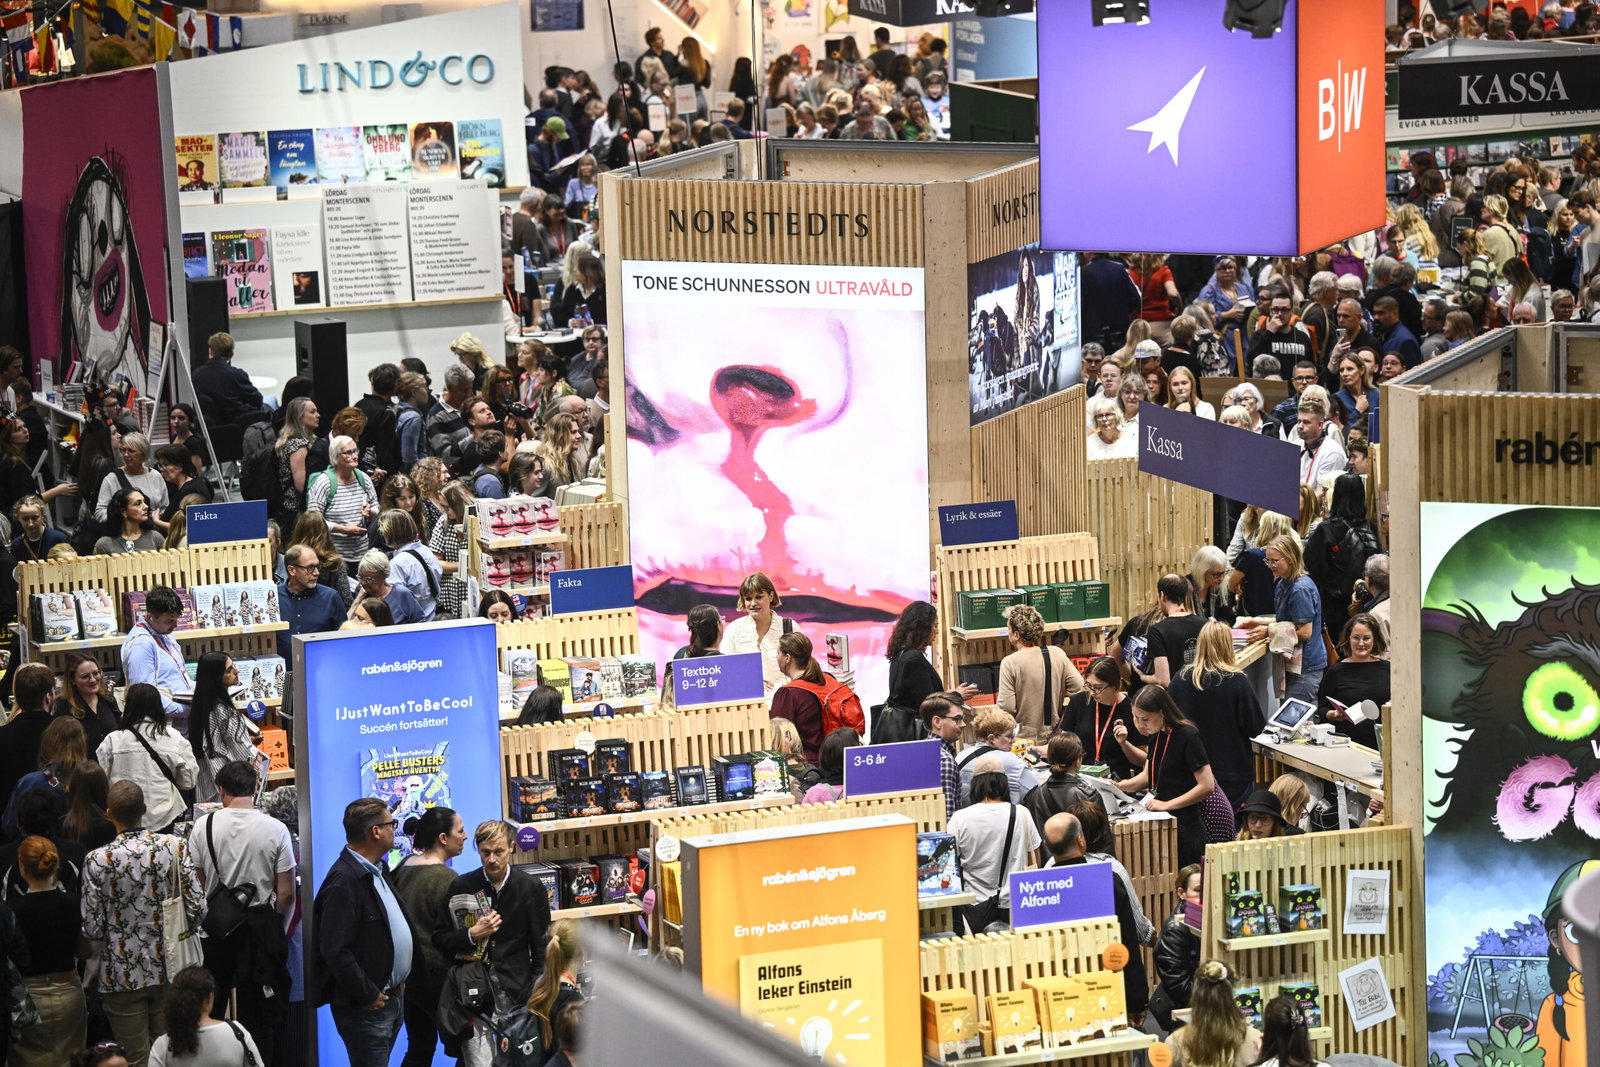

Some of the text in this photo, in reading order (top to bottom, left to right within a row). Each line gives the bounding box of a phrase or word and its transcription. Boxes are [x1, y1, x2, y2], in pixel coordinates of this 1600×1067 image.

[296, 50, 495, 93] LIND&CO
[1459, 70, 1569, 106] KASSA
[1398, 116, 1480, 129] EVIGA KLASSIKER
[180, 137, 208, 146] MAO-
[325, 189, 348, 197] LÖRDAG
[409, 187, 431, 195] LÖRDAG
[992, 190, 1040, 228] NORST
[668, 209, 869, 238] NORSTEDTS
[632, 275, 913, 298] TONE SCHUNNESSON ULTRAVÅLD
[1271, 342, 1306, 356] PUMA
[1146, 425, 1184, 461] Kassa
[194, 511, 218, 521] Fakta
[945, 510, 1002, 524] Lyrik & essäer
[557, 577, 582, 588] Fakta
[361, 659, 443, 676] rabén&sjögren
[681, 665, 721, 678] Textbok
[708, 677, 719, 688] år
[360, 716, 449, 735] Succén fortsätter!
[371, 755, 446, 772] PELLE BUSTERS
[854, 754, 886, 767] 3-6 år
[762, 865, 856, 887] rabén&sjögren
[1019, 876, 1073, 896] Nytt med
[1021, 893, 1060, 908] Alfons!
[734, 909, 886, 938] En ny bok om Alfons Åberg
[758, 964, 802, 981] Alfons
[758, 976, 852, 1001] leker Einstein
